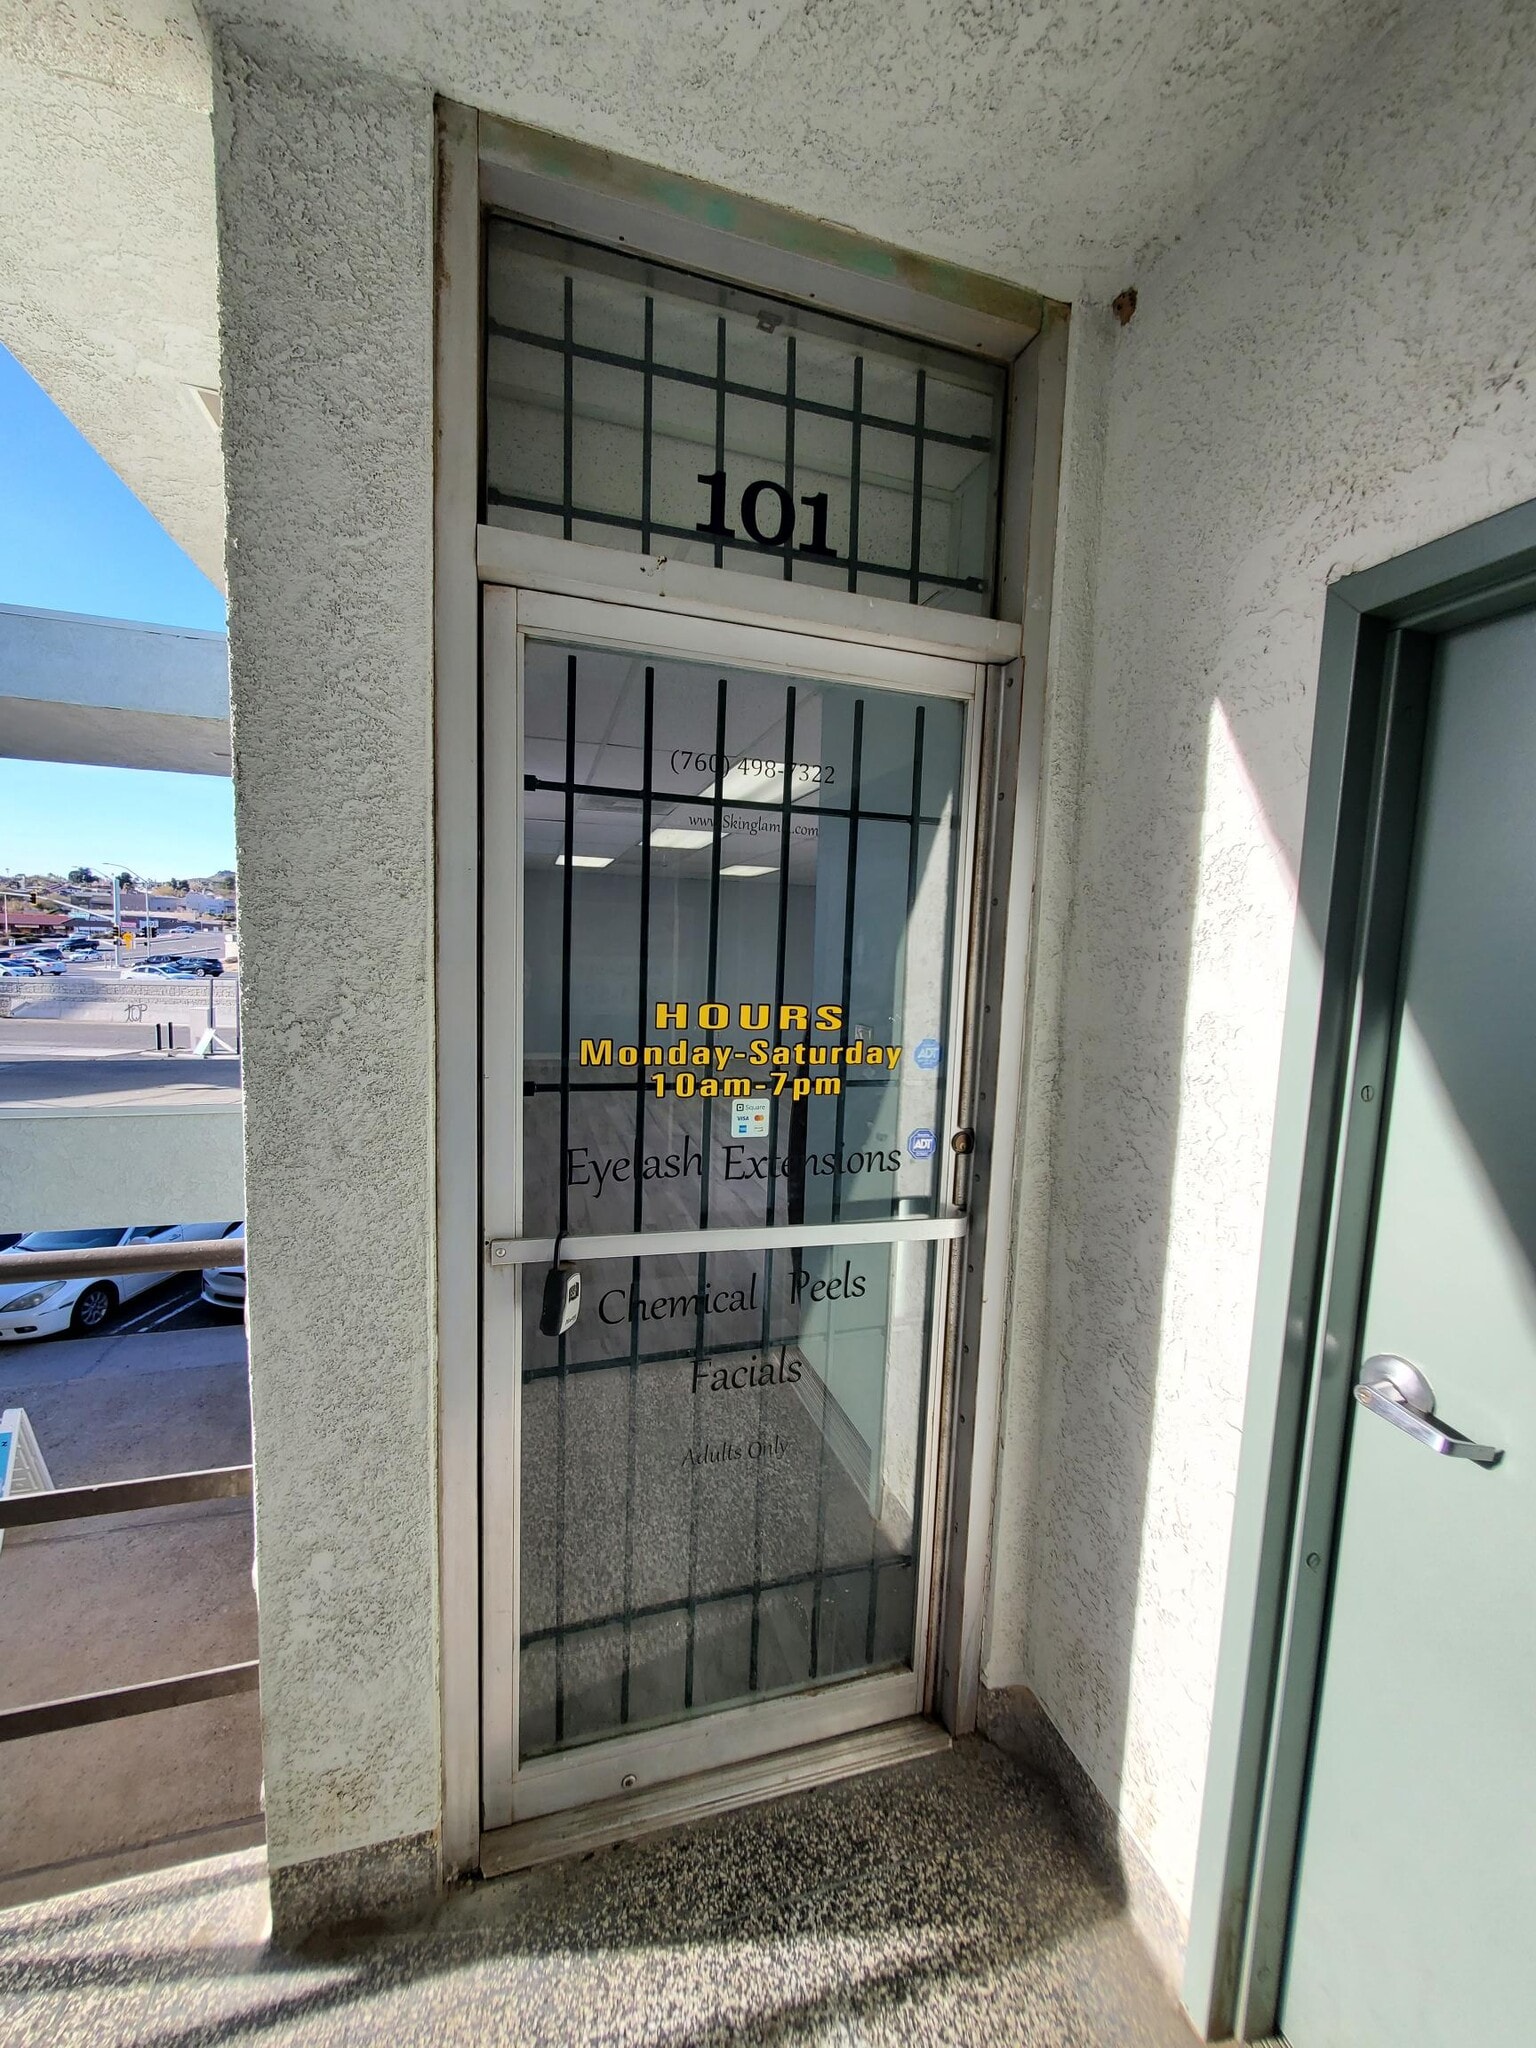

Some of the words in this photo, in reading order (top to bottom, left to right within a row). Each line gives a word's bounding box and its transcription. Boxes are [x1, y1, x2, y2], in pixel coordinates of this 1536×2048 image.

[696, 470, 838, 558] 101
[671, 749, 730, 777] (760)
[738, 757, 835, 784] 498-7322
[654, 1002, 844, 1031] HOURS
[579, 1038, 902, 1070] Monday-Saturday
[918, 1047, 939, 1059] ADT
[650, 1072, 842, 1100] 10am-7pm
[913, 1138, 933, 1150] ADT
[567, 1135, 702, 1199] Eyelash
[721, 1142, 902, 1181] Extensions
[598, 1272, 758, 1325] Chemical
[788, 1260, 866, 1304] Peels
[691, 1344, 803, 1393] Facials
[681, 1441, 742, 1467] Adults
[747, 1434, 789, 1460] Only
